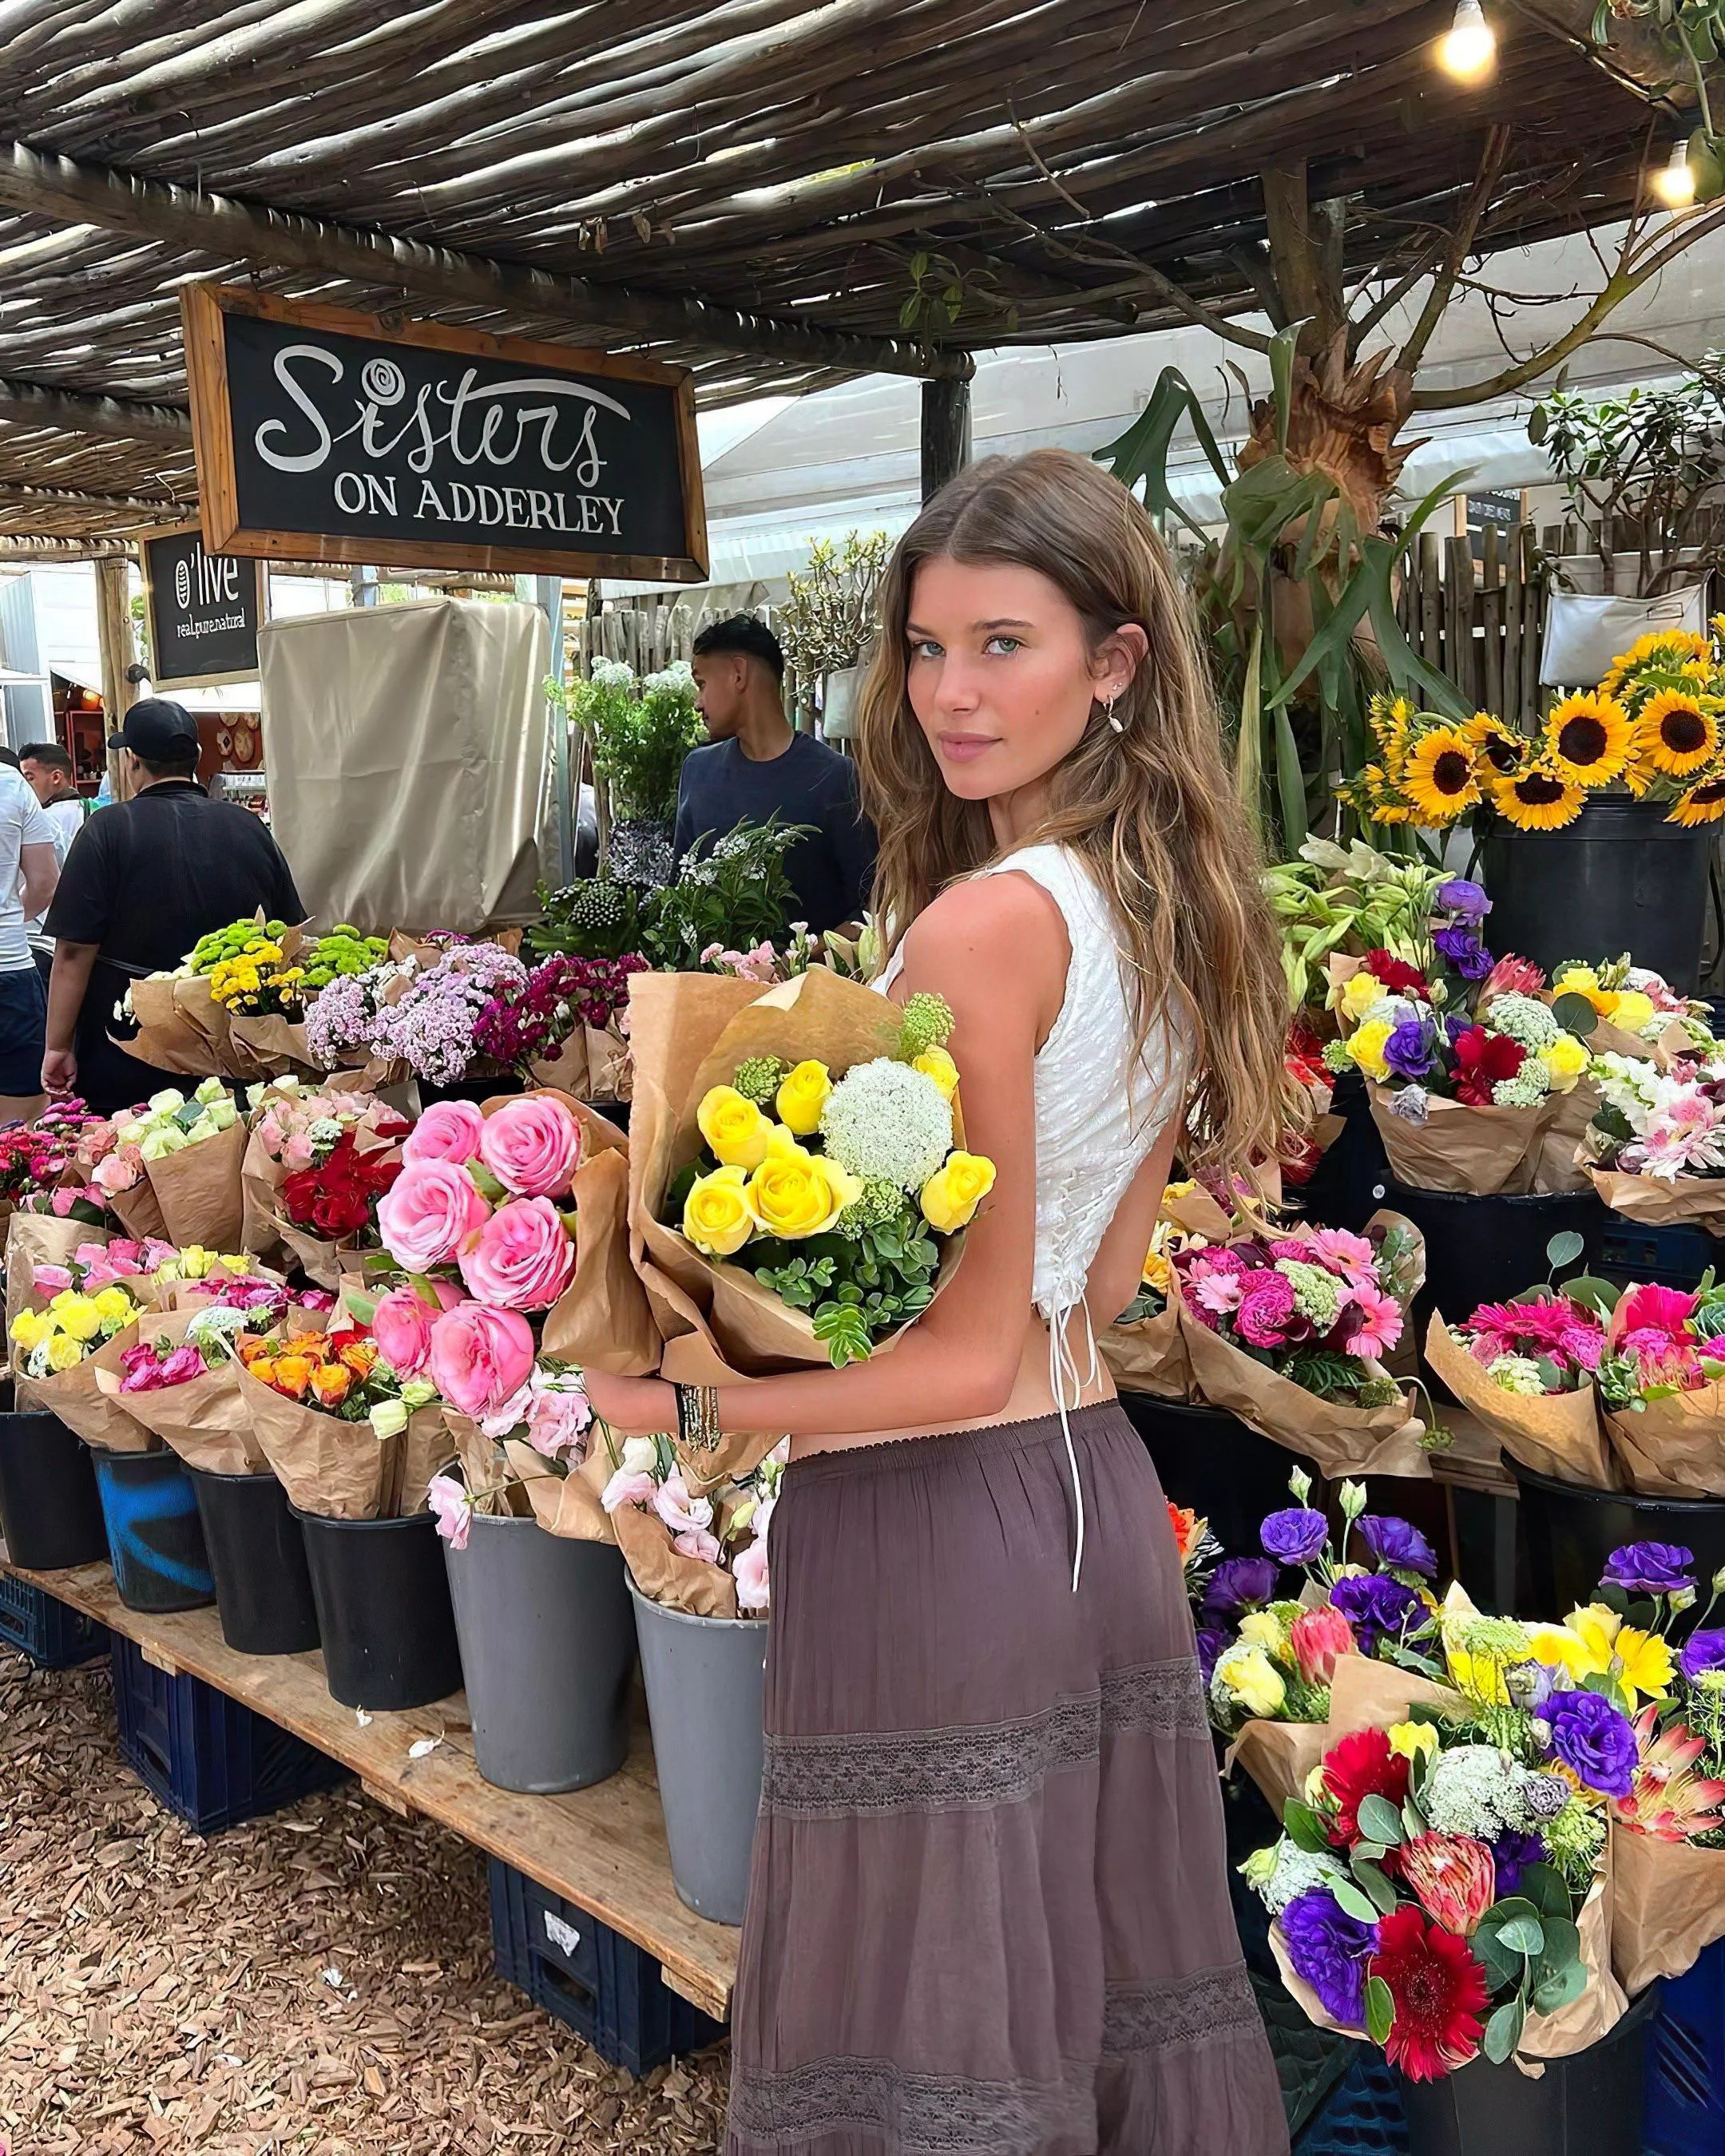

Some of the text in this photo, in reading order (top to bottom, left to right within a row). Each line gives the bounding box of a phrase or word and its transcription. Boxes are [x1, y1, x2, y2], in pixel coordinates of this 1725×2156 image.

[255, 345, 631, 489] Sisters
[334, 471, 625, 536] ON ADDERLEY
